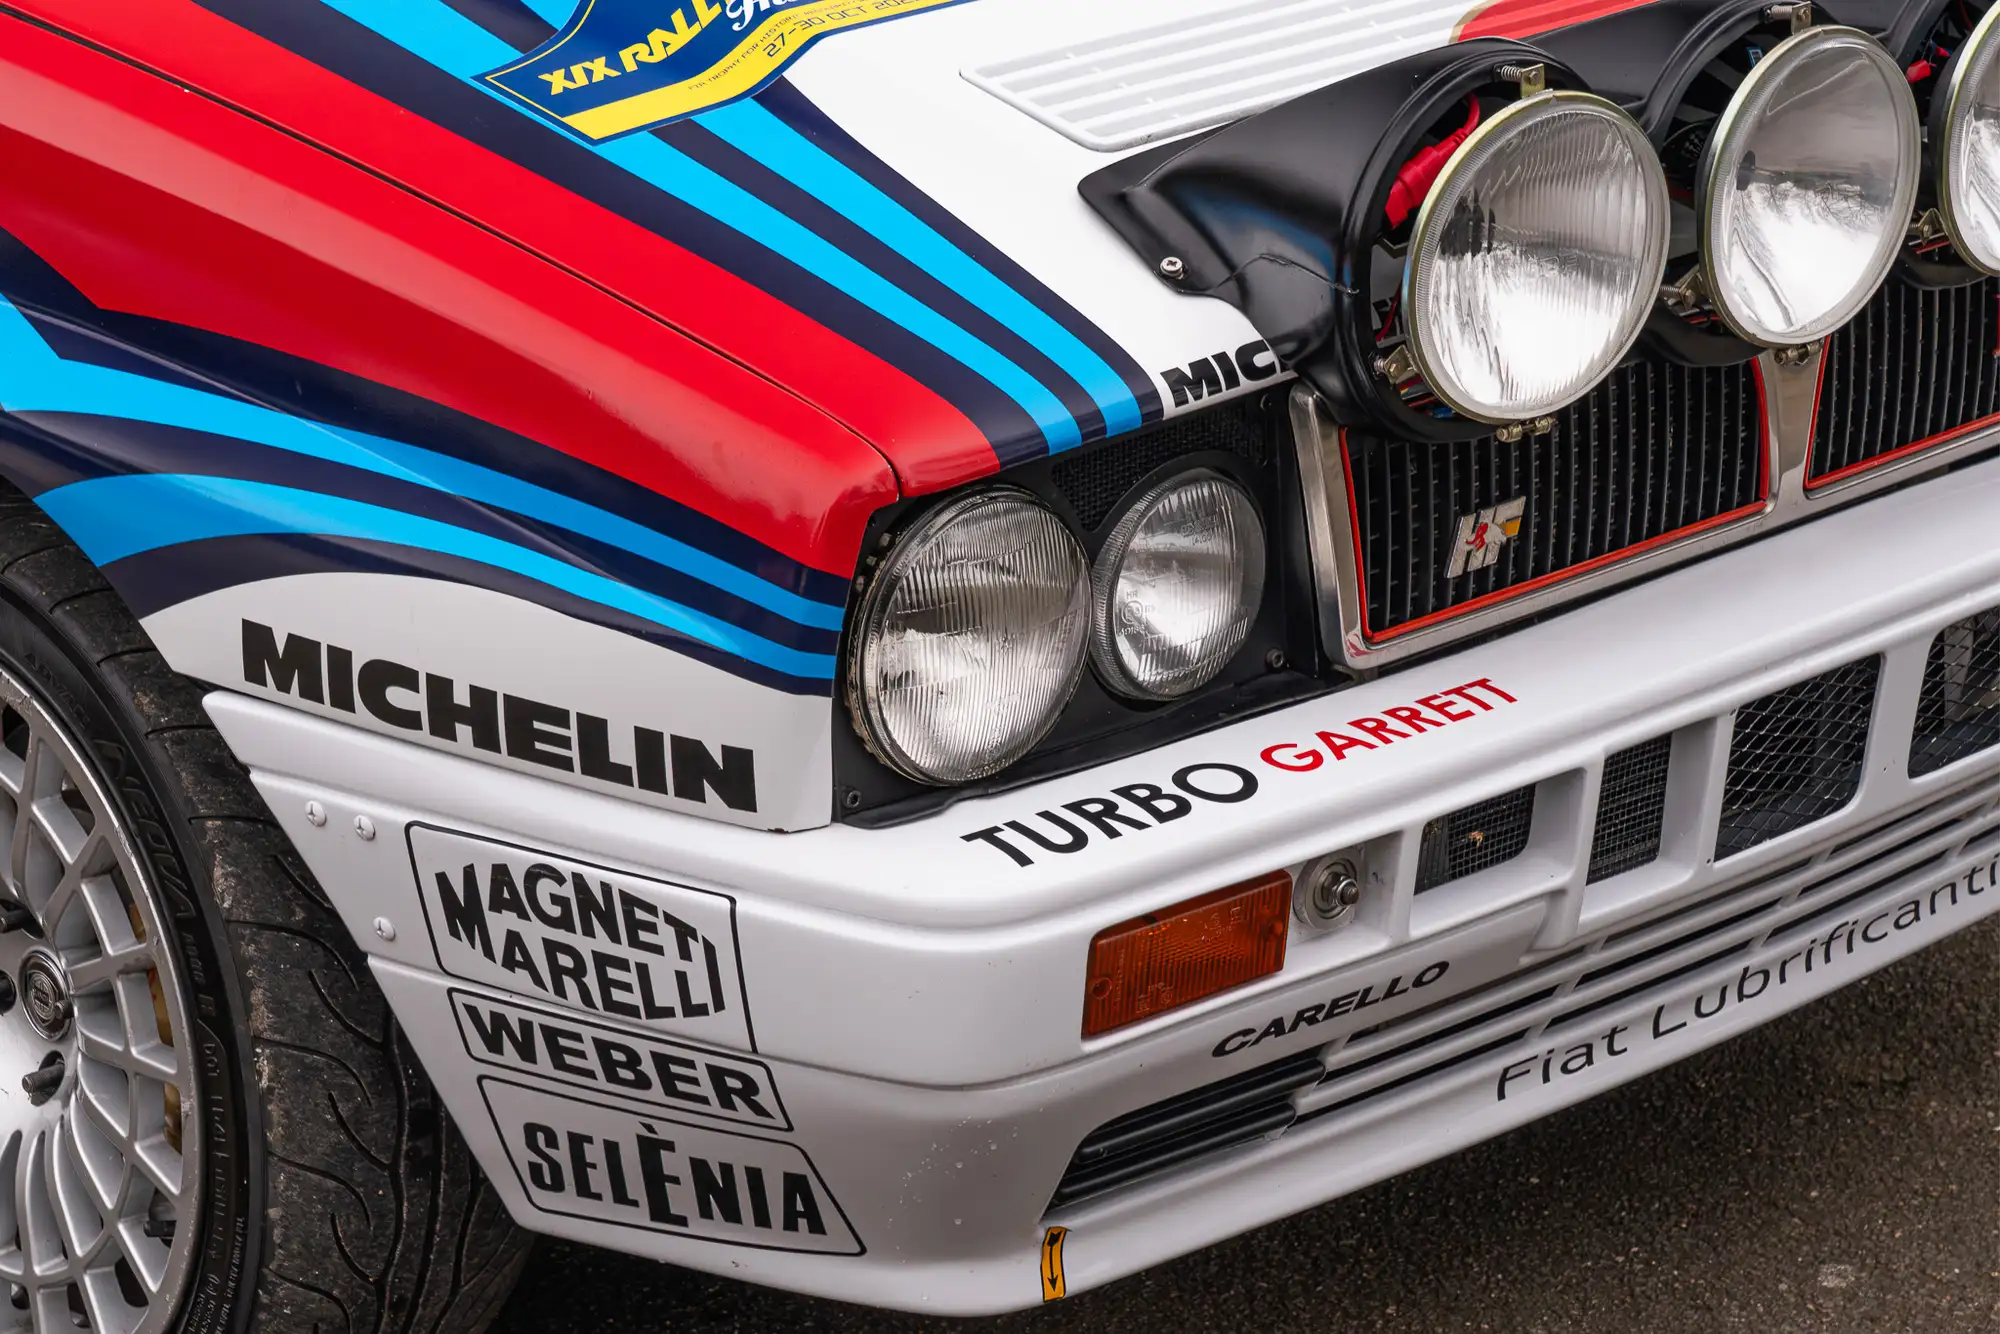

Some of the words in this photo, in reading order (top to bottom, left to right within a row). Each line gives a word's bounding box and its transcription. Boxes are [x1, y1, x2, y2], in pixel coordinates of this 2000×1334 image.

[538, 56, 622, 95] XIX
[618, 0, 732, 73] RALL
[762, 16, 826, 58] 27-30
[826, 6, 867, 21] OCT
[1160, 339, 1291, 408] MIC
[242, 618, 758, 814] MICHELIN
[960, 762, 1259, 867] TURBO
[1260, 677, 1519, 772] GARRETT
[434, 862, 727, 990] MAGNETI
[434, 890, 727, 1021] MARELLI
[1497, 1025, 1629, 1102] Fiat
[1652, 850, 2000, 1040] Lubrificanti
[461, 1001, 776, 1121] WEBER
[1212, 961, 1450, 1058] CARELLO
[523, 1120, 828, 1237] SELÈNIA
